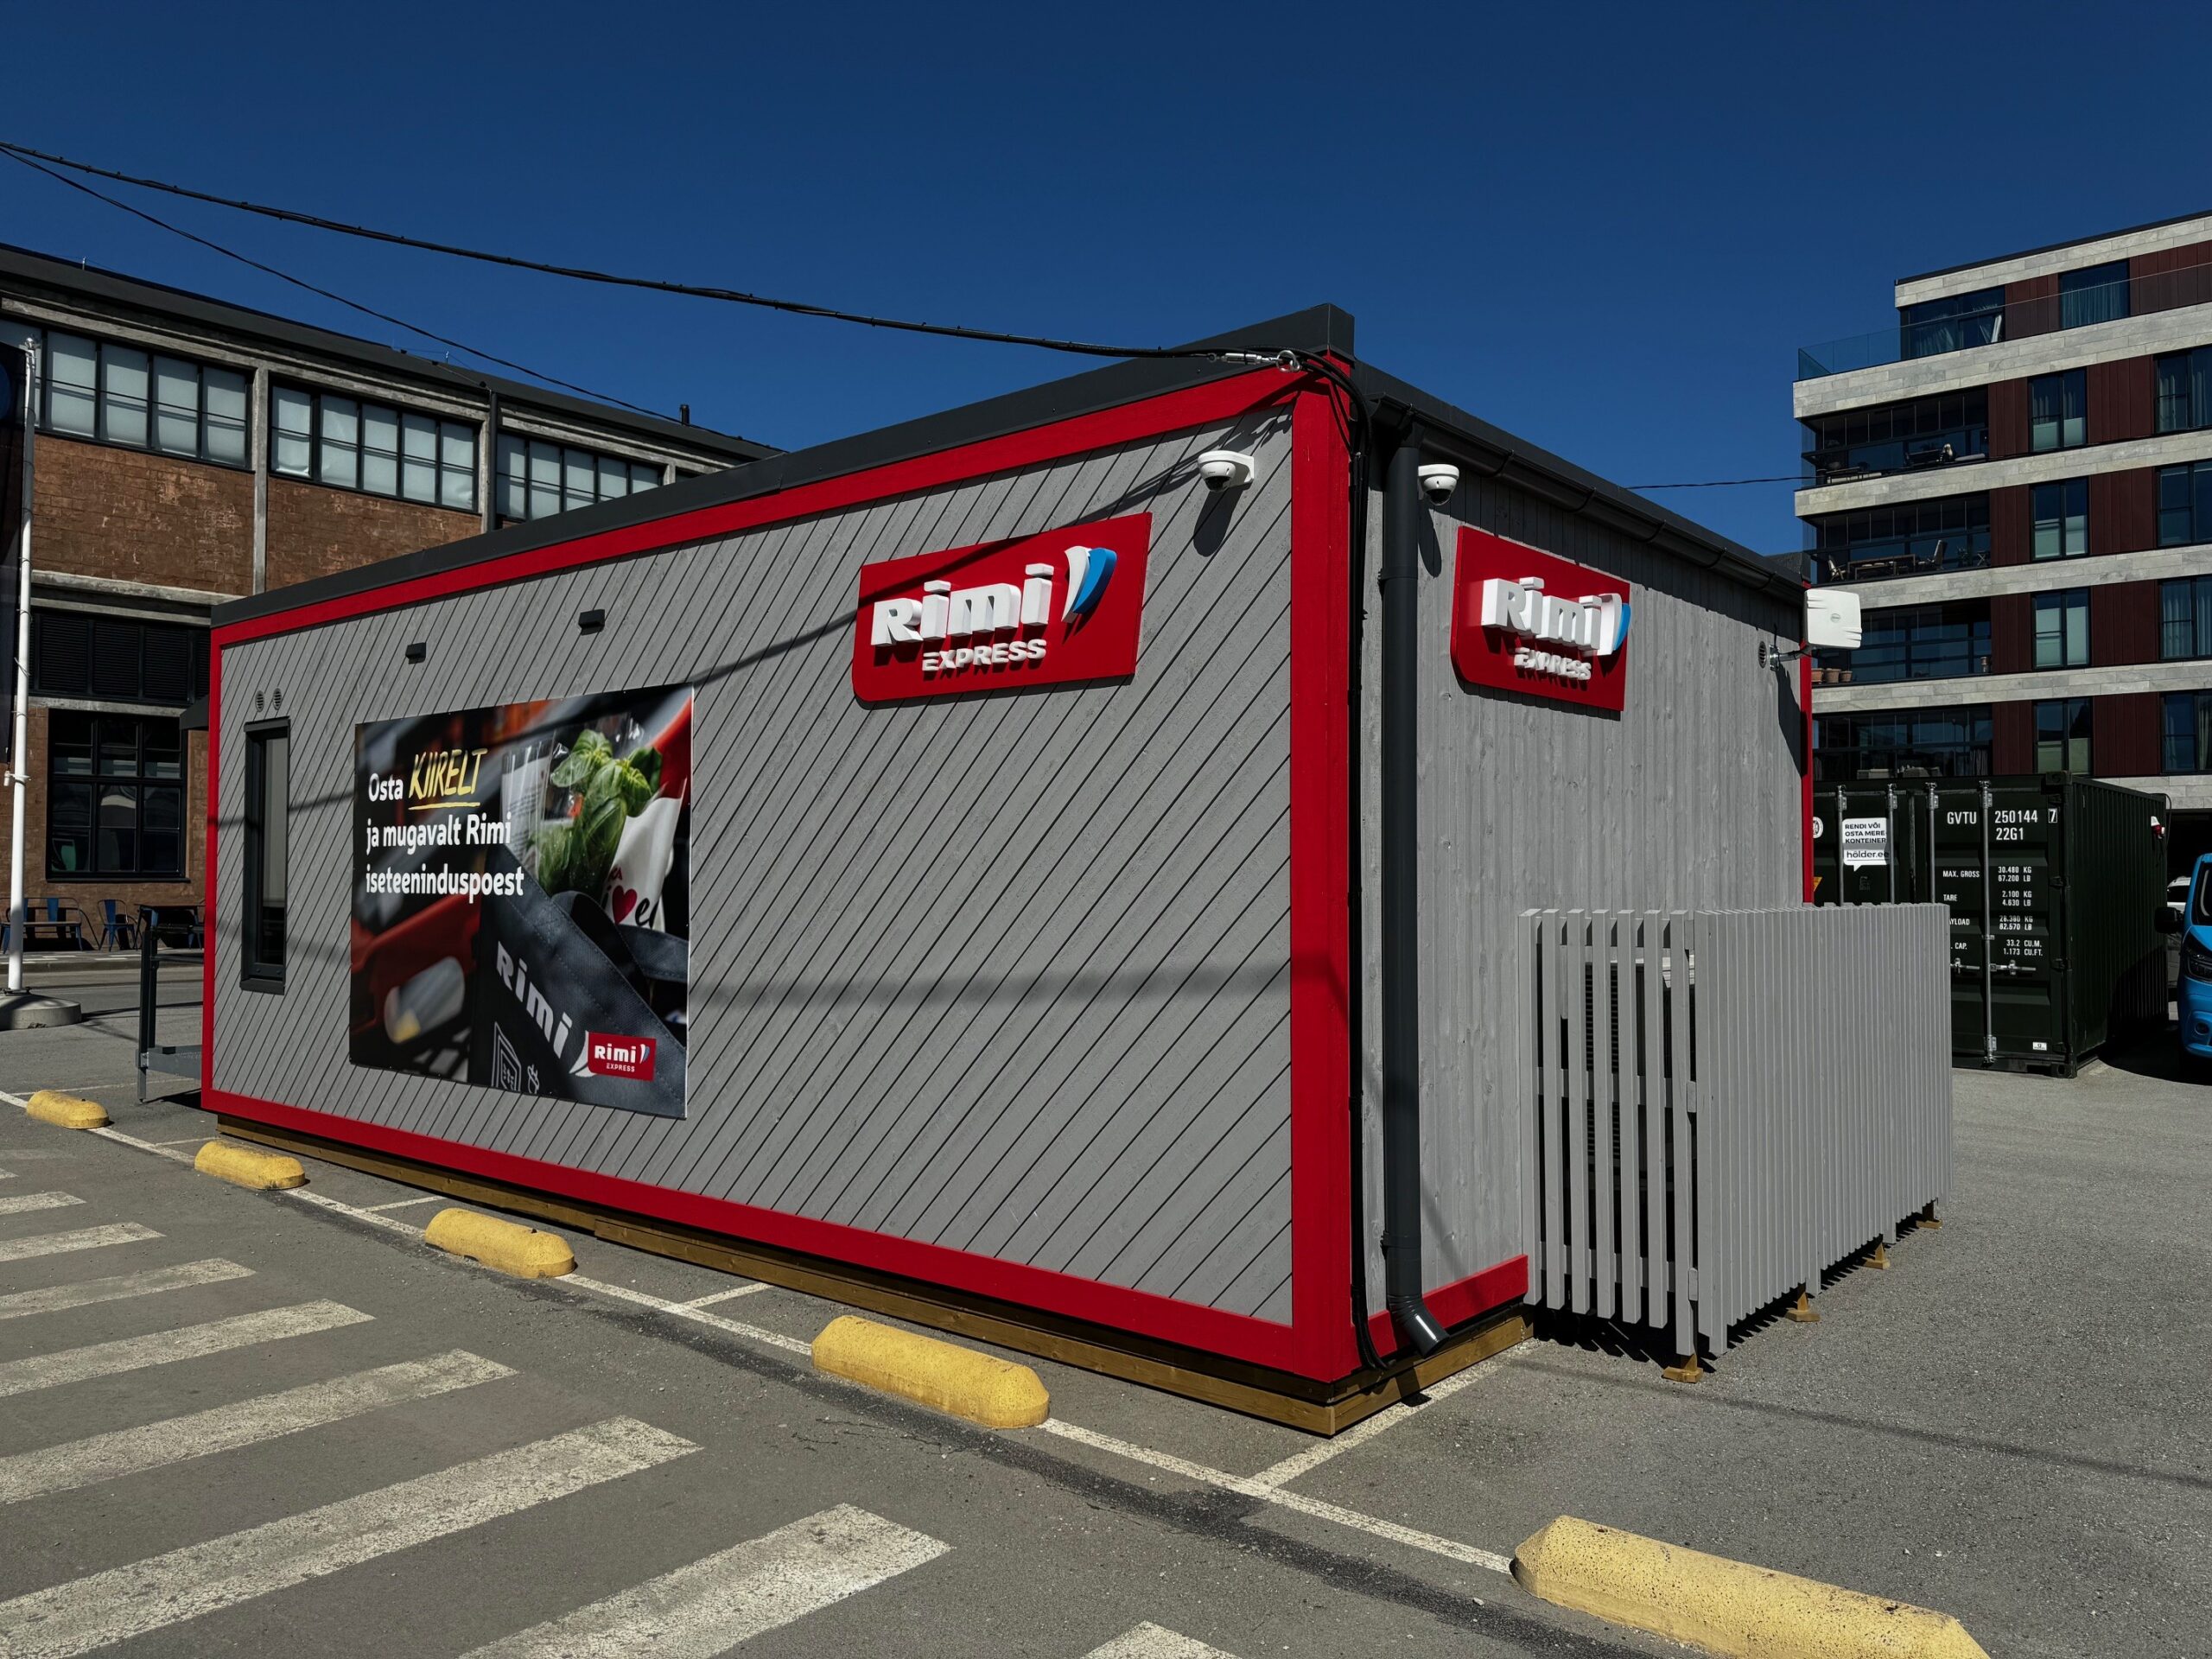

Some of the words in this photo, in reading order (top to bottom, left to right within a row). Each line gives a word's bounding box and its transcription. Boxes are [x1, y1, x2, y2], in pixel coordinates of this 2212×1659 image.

[870, 563, 1054, 646] Rimi
[1481, 576, 1603, 651] Rimi
[922, 639, 1046, 671] EXPRESS
[1514, 647, 1592, 681] EXPRESS
[368, 773, 404, 801] Osta
[1947, 811, 1977, 824] GVTU
[1994, 810, 2037, 823] 250144
[366, 818, 379, 855] ja
[383, 814, 461, 855] mugavalt
[466, 811, 512, 845] Rimi
[1996, 827, 2024, 841] 22G1
[366, 863, 524, 904] iseteeninduspoest
[2024, 939, 2043, 948] CU.M.
[2024, 948, 2044, 957] CU.FT.
[496, 940, 573, 1059] Rimi
[594, 1043, 637, 1064] Rimi
[607, 1063, 635, 1072] EXPRESS
